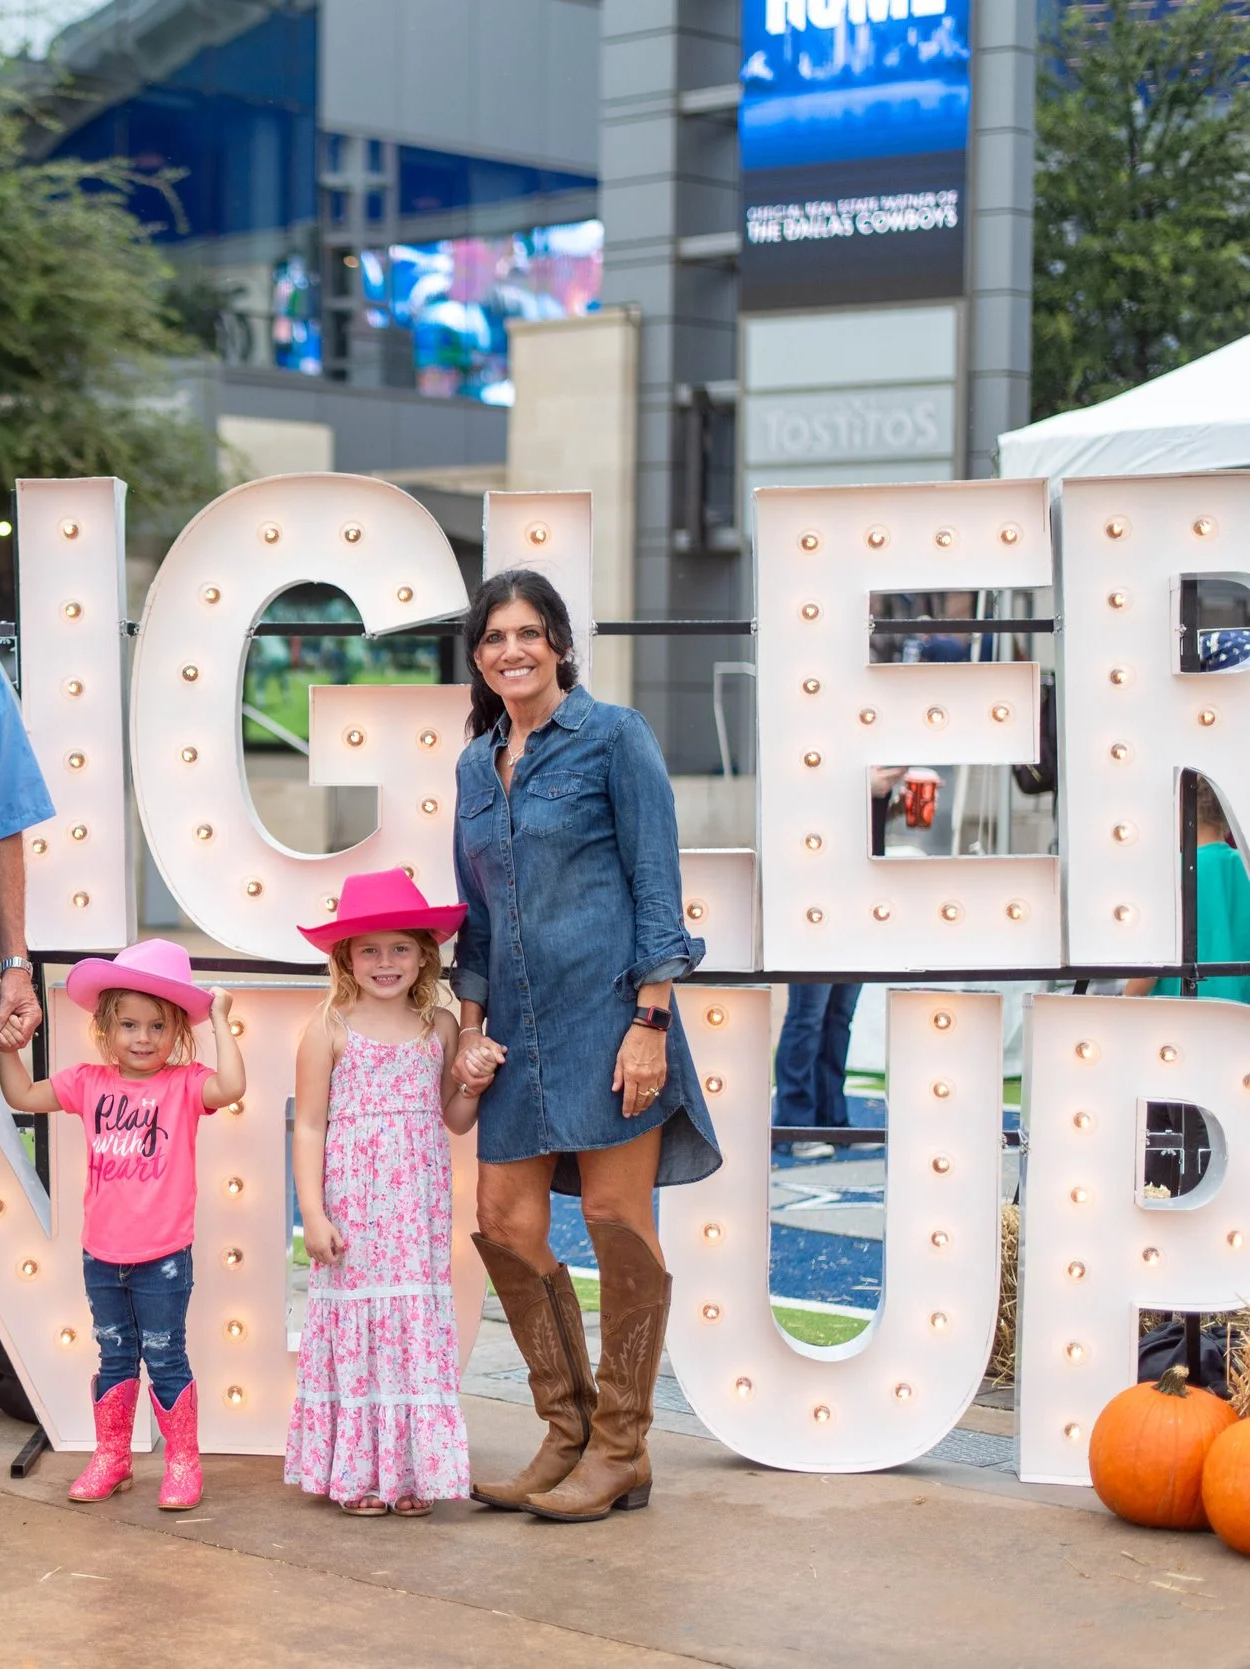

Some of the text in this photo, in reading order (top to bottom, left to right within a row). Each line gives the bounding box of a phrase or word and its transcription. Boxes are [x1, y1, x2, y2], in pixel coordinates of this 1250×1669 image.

[747, 205, 958, 243] THE DALLAS COWBOYS
[92, 1130, 145, 1156] with
[95, 1093, 168, 1157] Play
[88, 1147, 168, 1197] Heart
